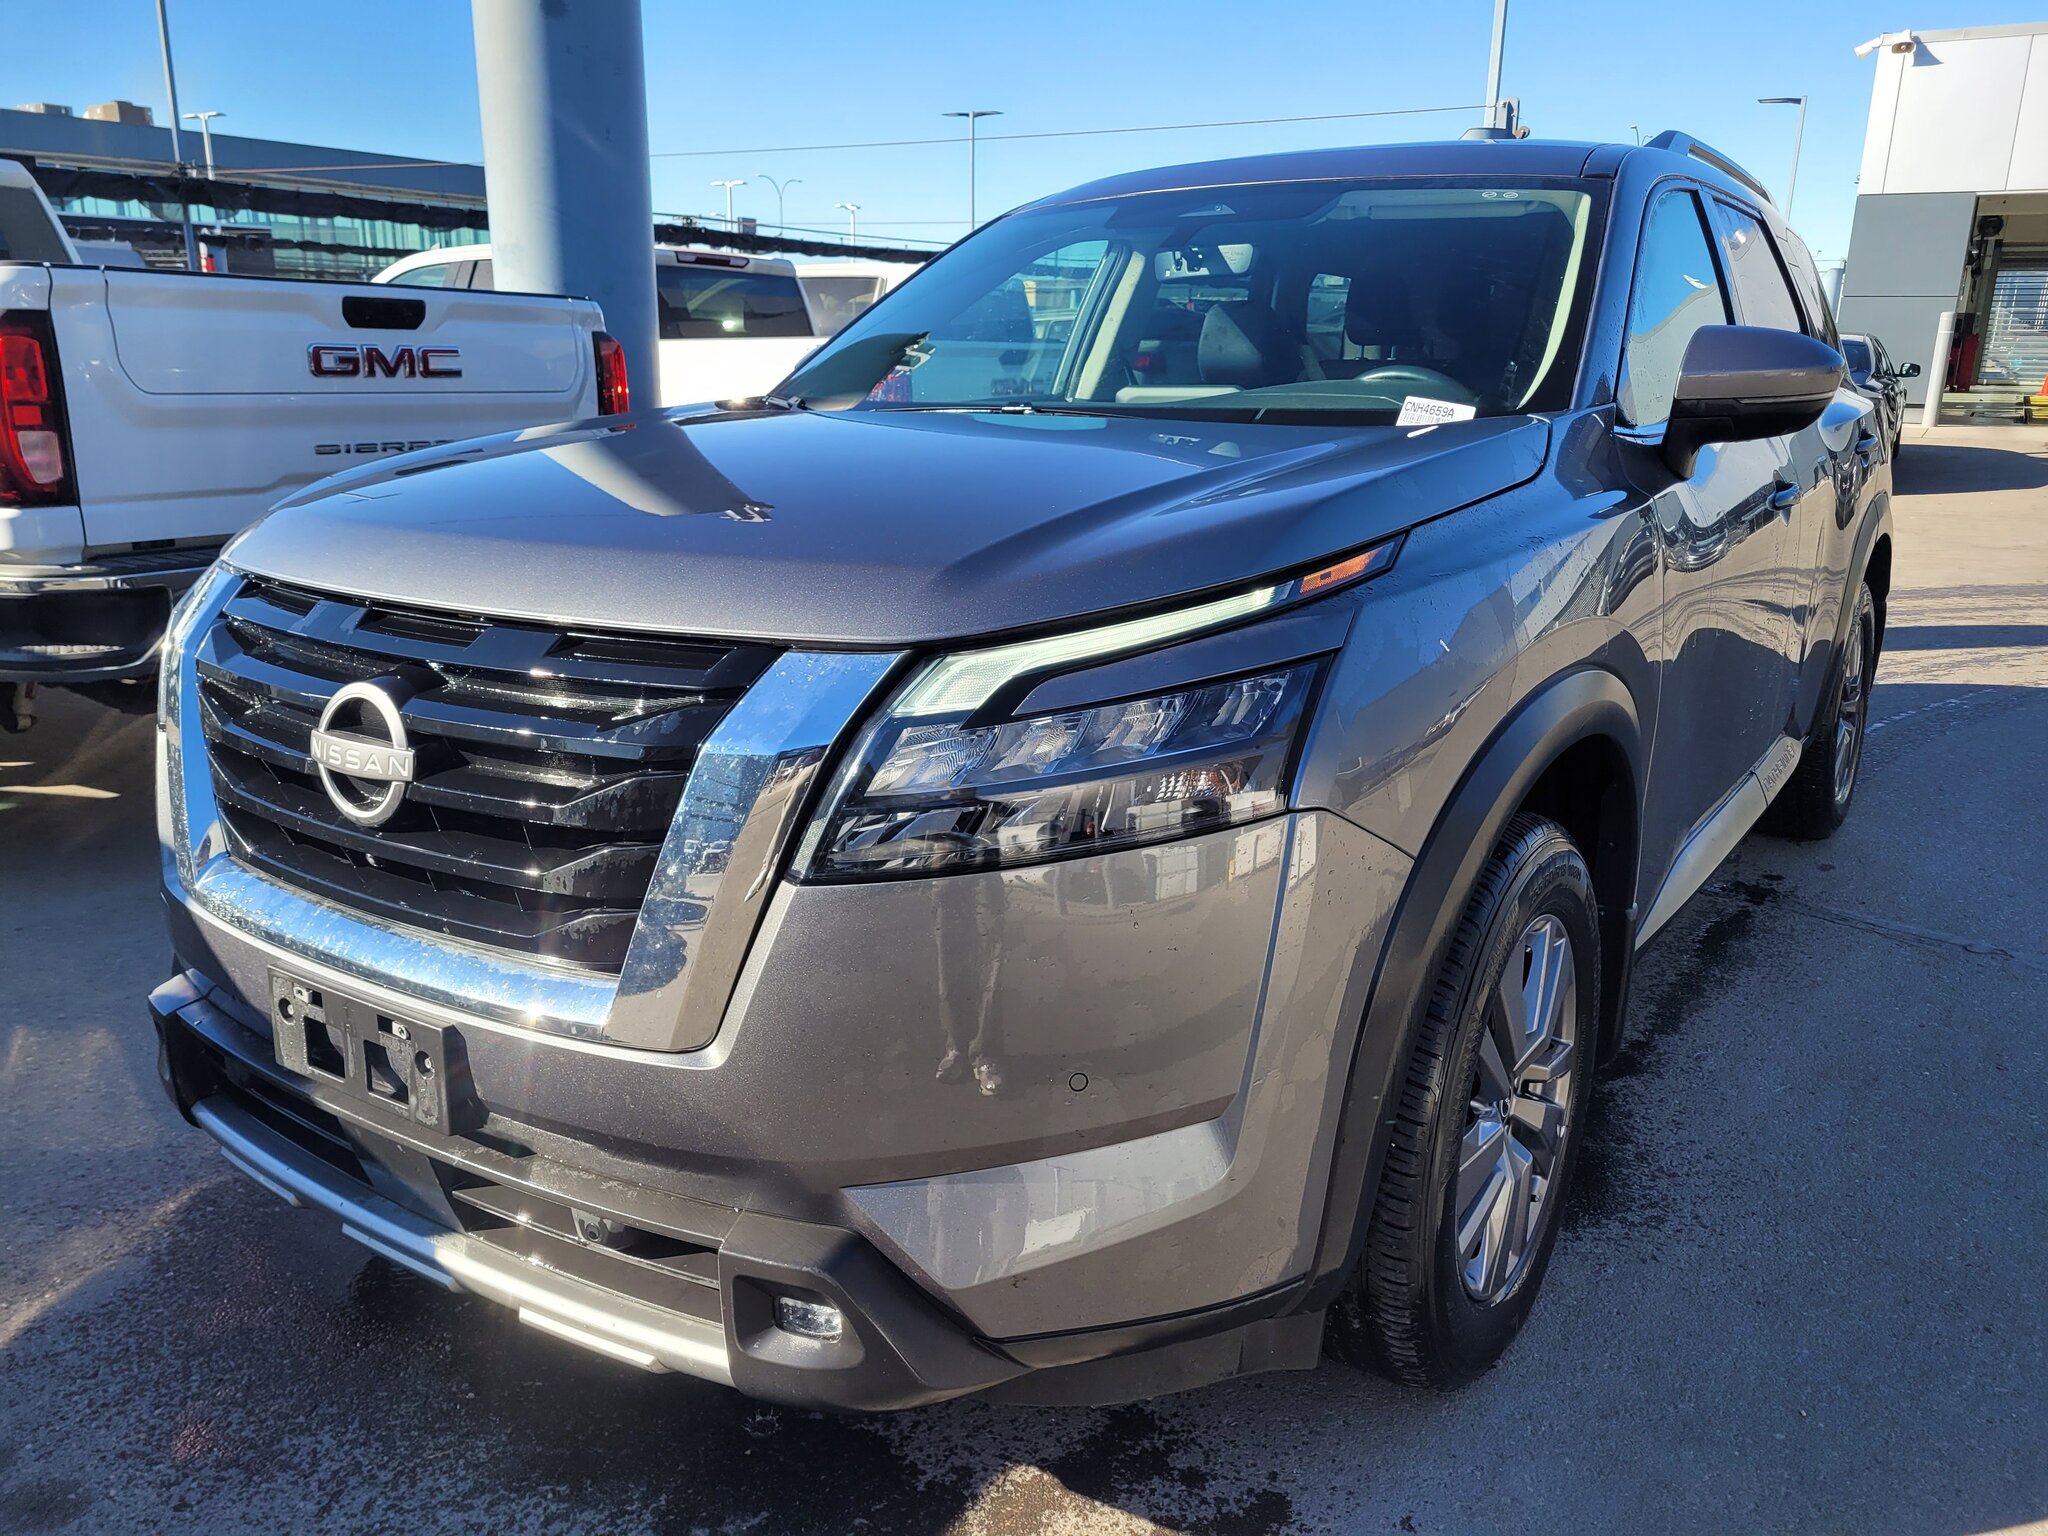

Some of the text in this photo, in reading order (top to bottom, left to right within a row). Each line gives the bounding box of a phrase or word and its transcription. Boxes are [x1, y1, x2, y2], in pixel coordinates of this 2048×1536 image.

[307, 342, 463, 378] GMC
[1404, 401, 1455, 419] CNH4659A
[314, 439, 456, 455] SIERR
[311, 737, 409, 777] NISSAN
